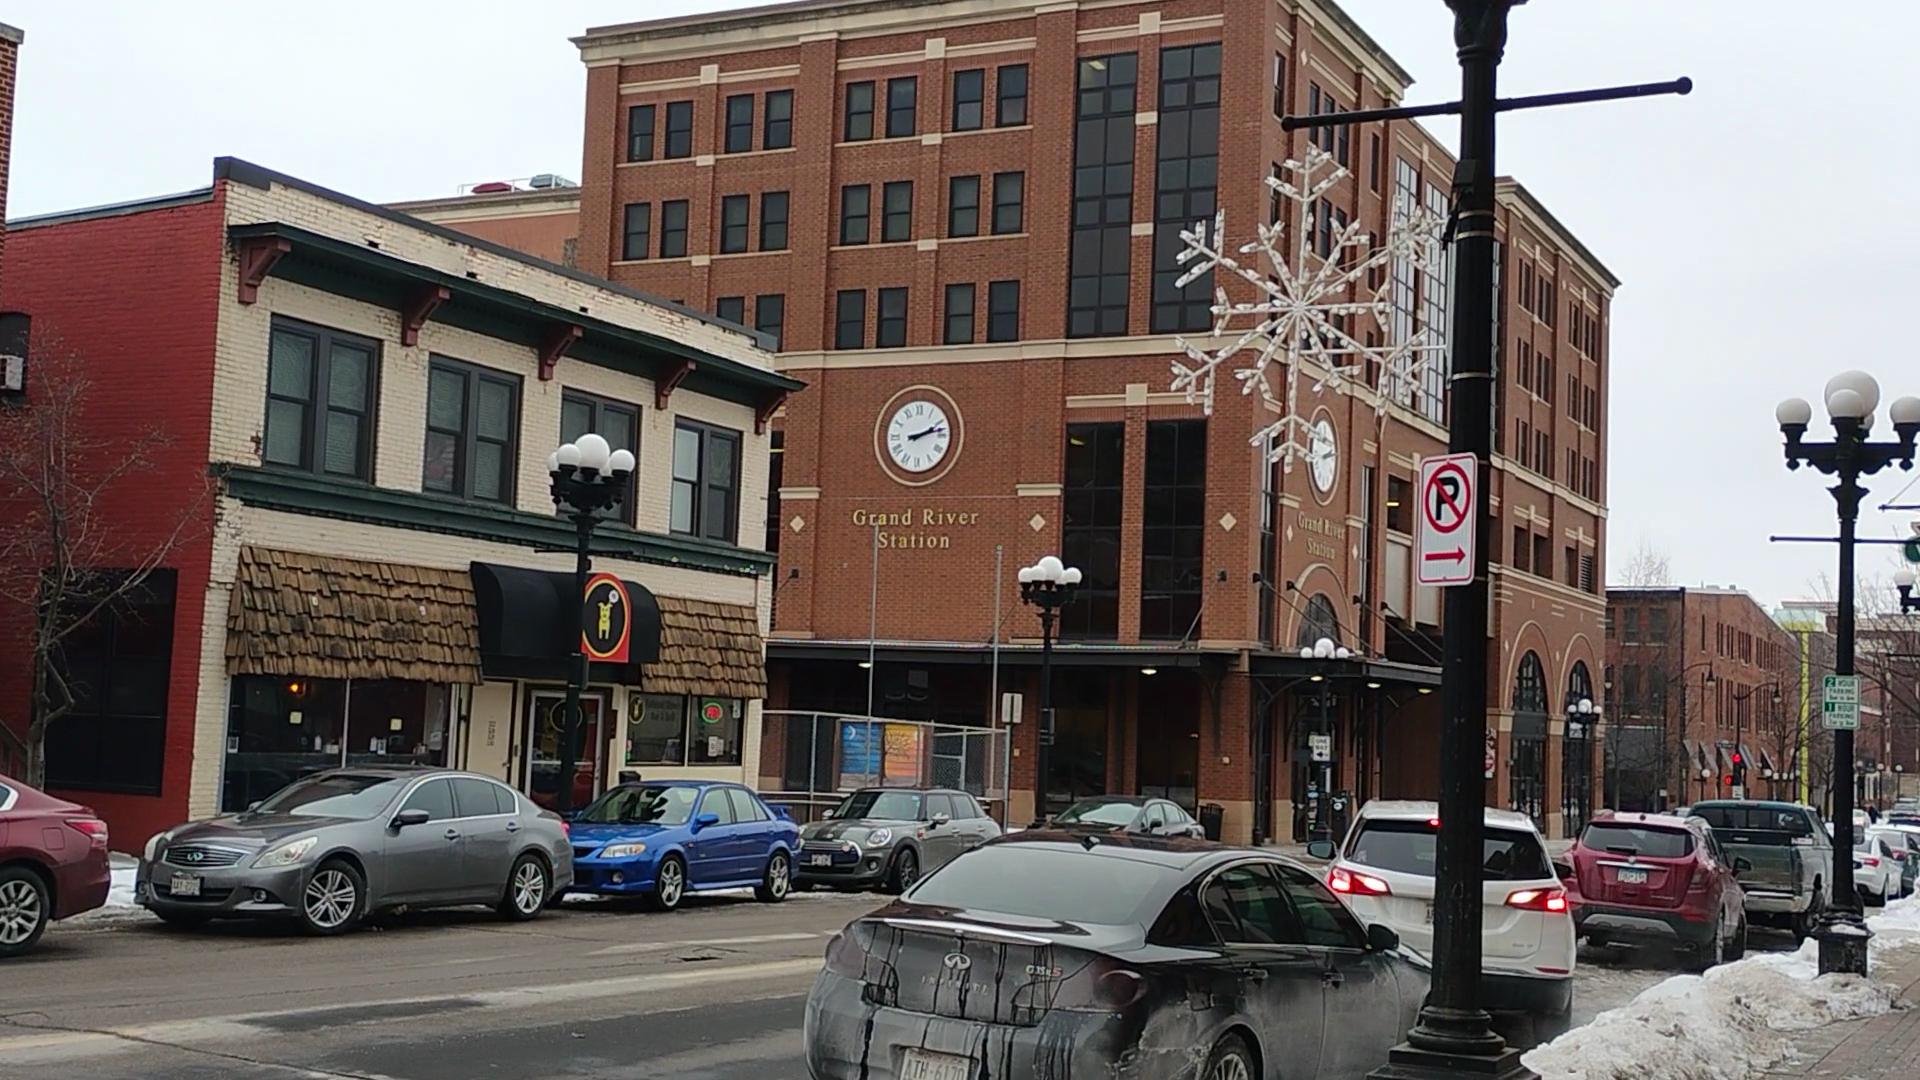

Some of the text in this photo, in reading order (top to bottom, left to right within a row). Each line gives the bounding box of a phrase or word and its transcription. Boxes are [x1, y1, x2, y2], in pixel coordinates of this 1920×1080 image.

[853, 508, 979, 526] Grand River
[878, 531, 950, 549] Station
[1827, 678, 1835, 687] 2
